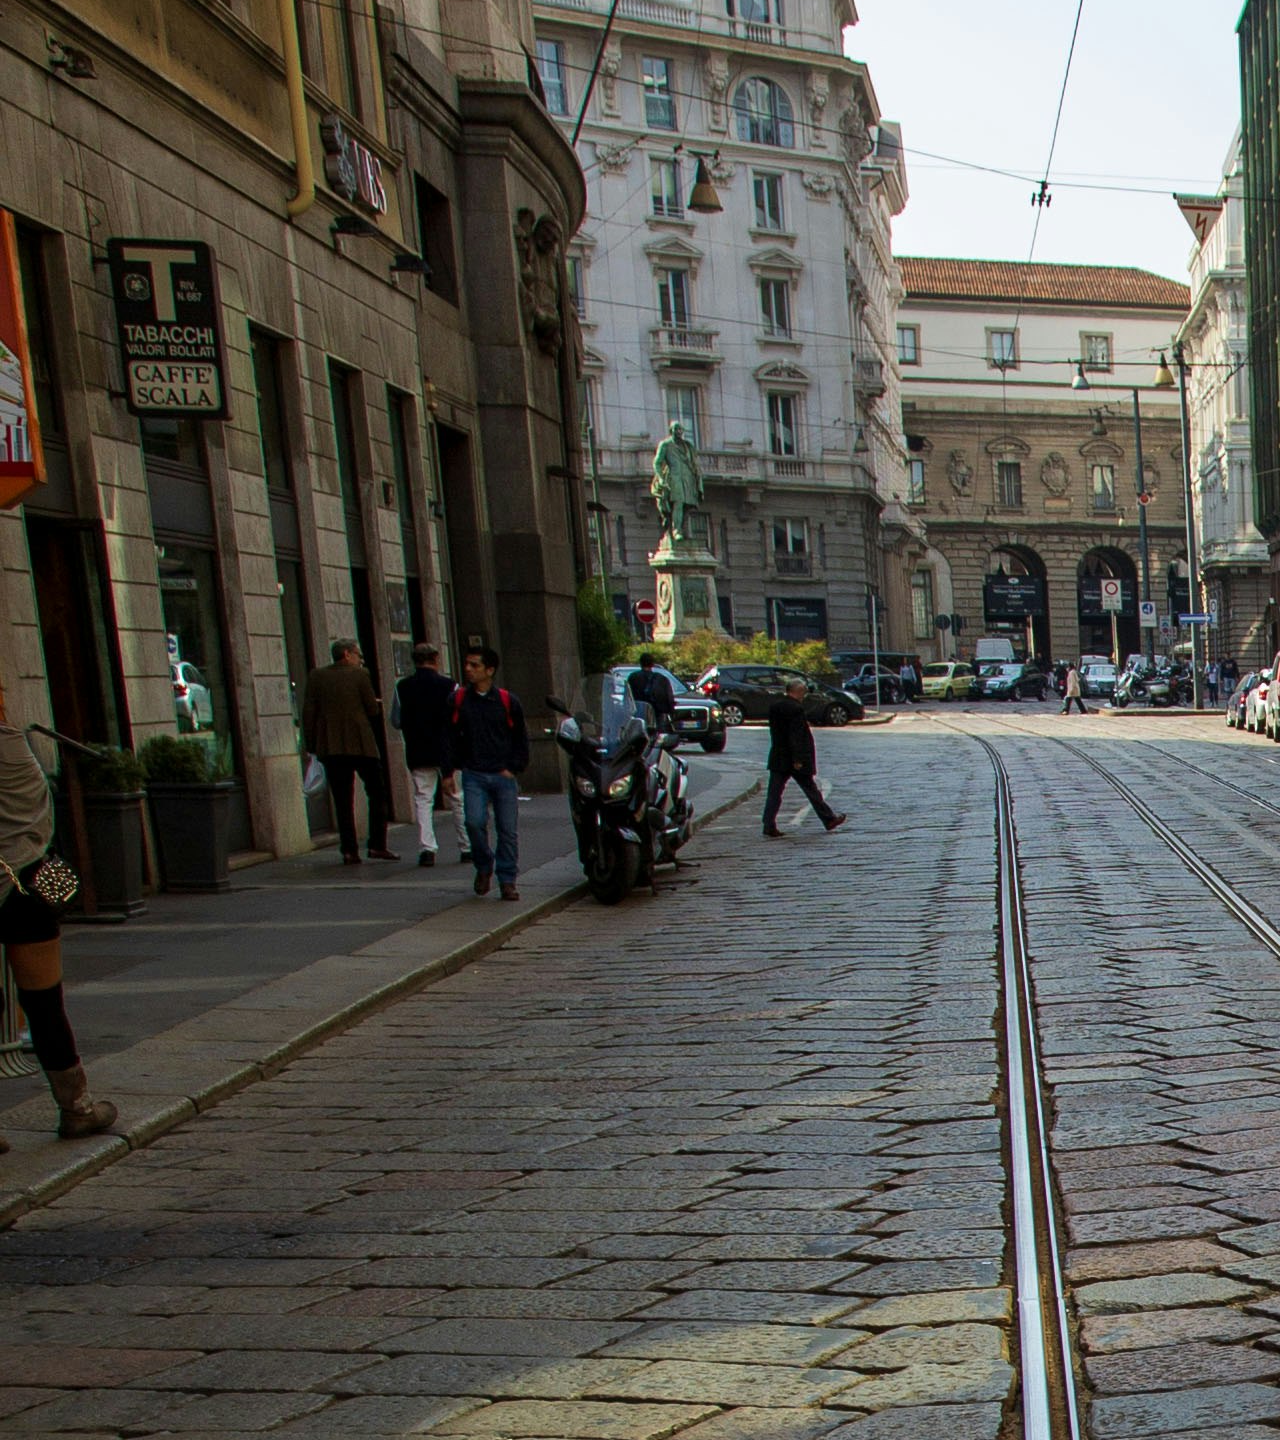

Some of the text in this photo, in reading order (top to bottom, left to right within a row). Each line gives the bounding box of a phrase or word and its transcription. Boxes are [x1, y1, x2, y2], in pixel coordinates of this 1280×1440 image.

[123, 247, 197, 322] T
[123, 324, 215, 345] TABACCHI
[126, 343, 216, 358] VALORI BOLLATI
[135, 364, 213, 385] CAFFE'
[137, 386, 214, 407] SCALA
